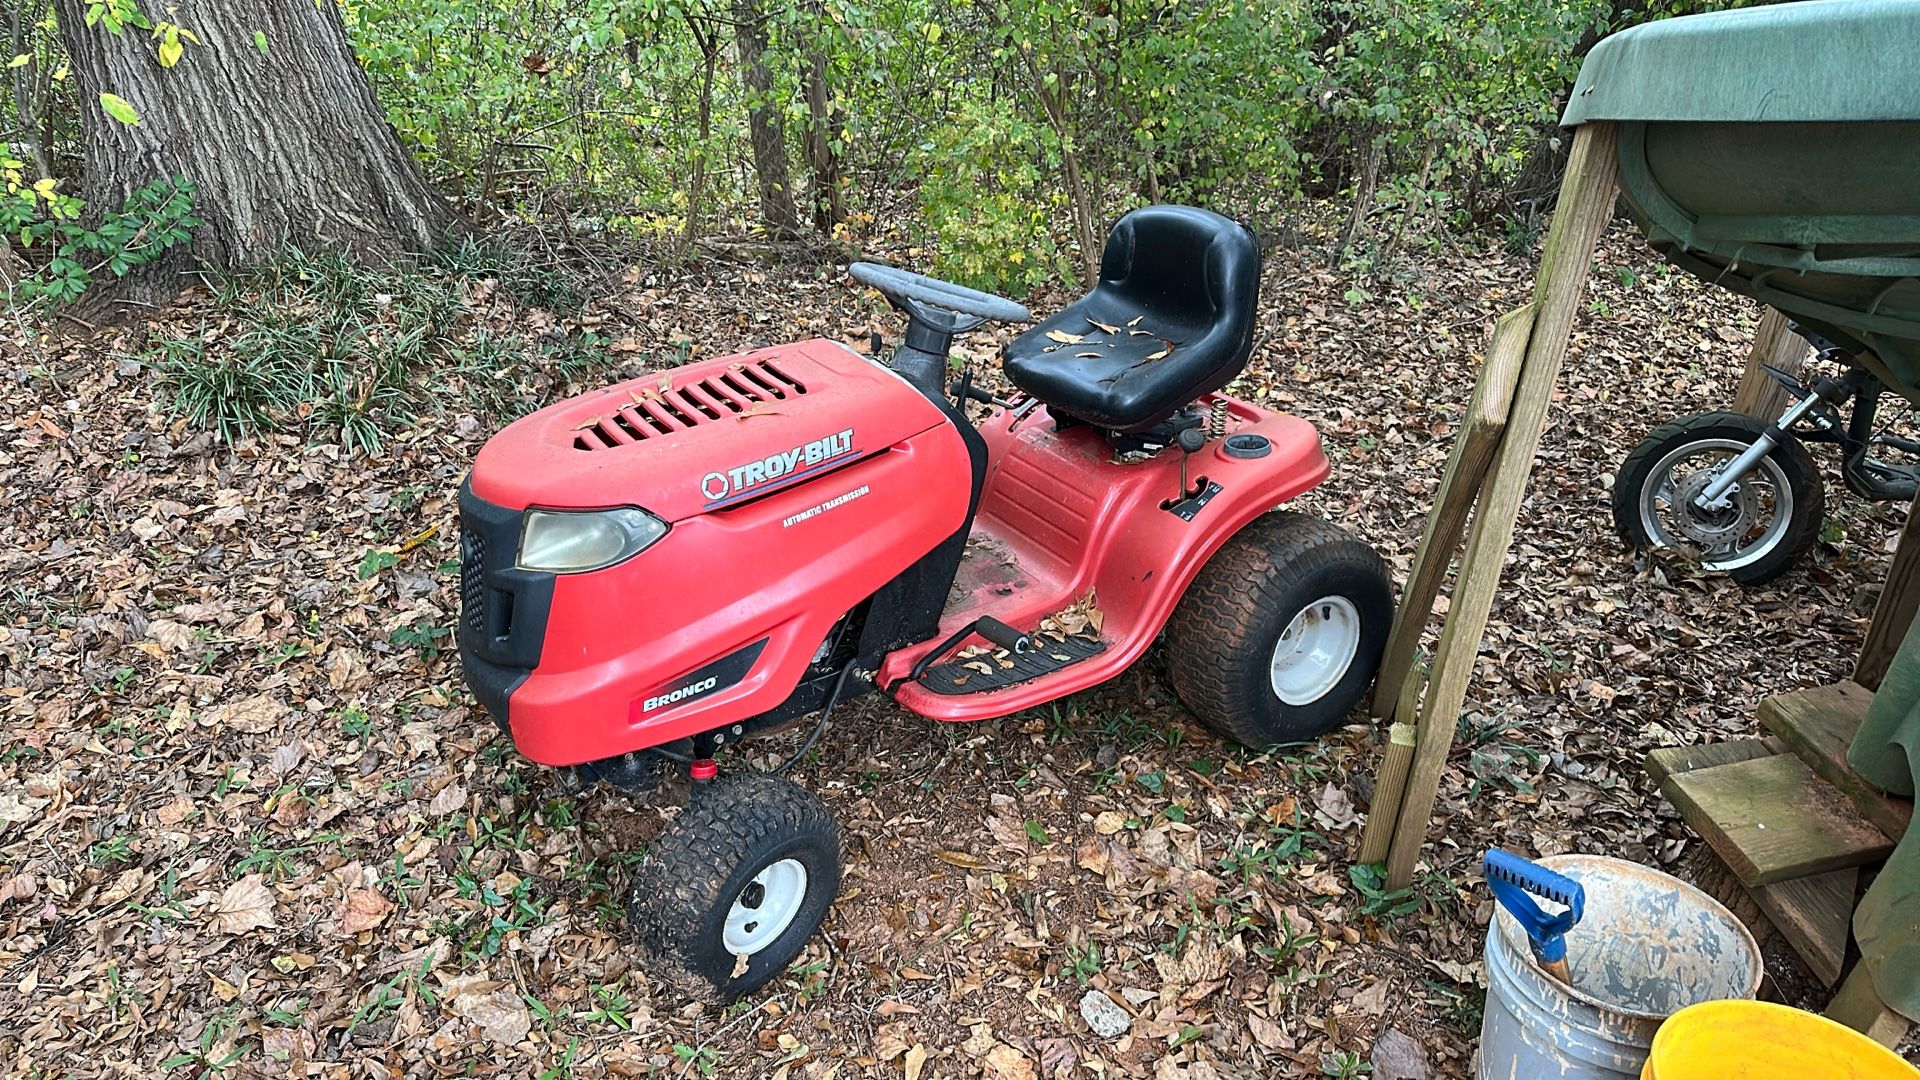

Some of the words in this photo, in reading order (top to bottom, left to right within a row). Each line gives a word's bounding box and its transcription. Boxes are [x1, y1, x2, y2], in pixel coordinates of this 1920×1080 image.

[728, 428, 854, 491] TROY-BILT
[783, 506, 822, 528] AUTOMATIC
[821, 485, 870, 512] TRANSMISSION
[643, 677, 717, 712] BRONCO
